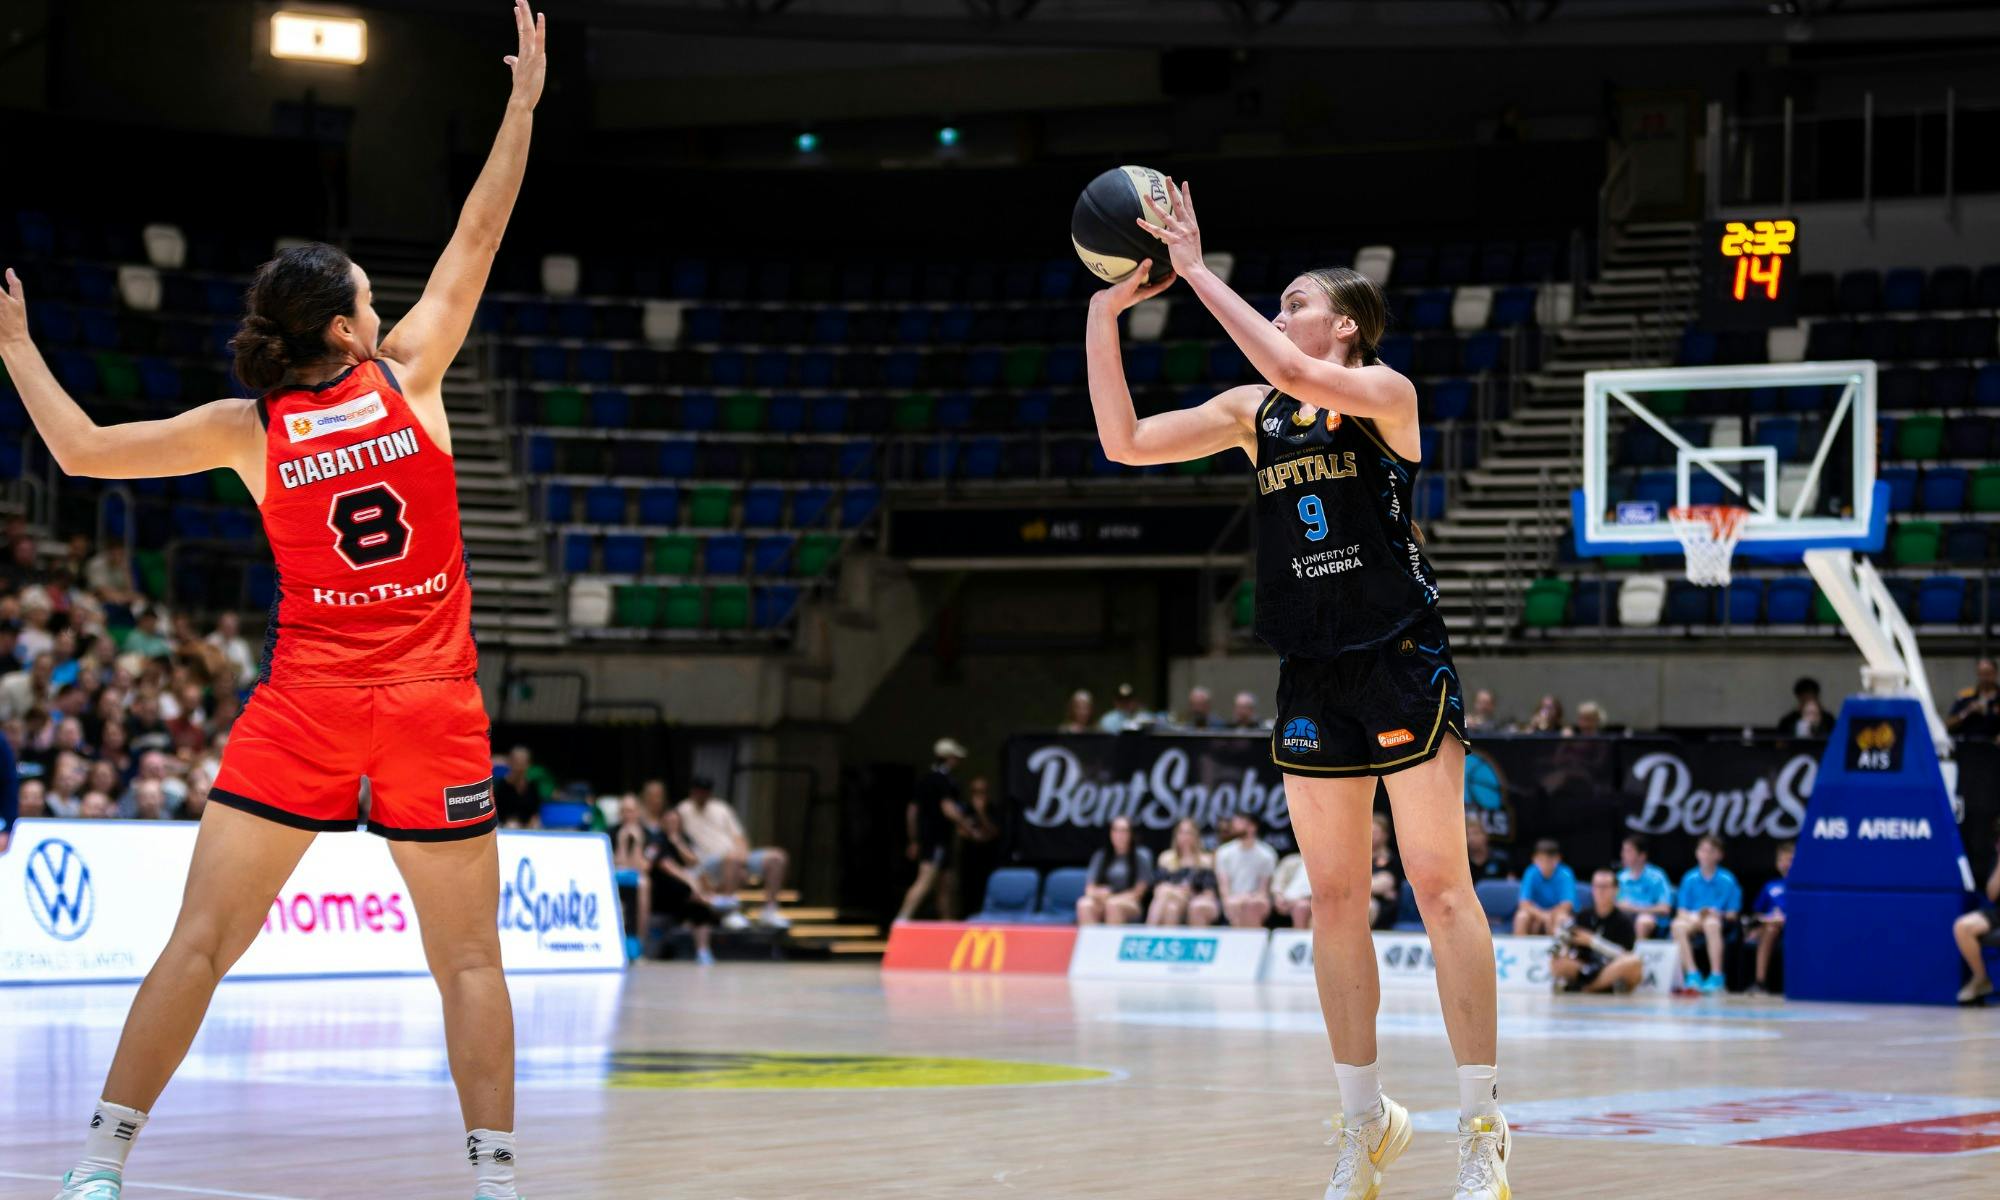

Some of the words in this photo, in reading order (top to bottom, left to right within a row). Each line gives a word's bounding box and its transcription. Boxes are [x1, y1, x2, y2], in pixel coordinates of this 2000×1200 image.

[1721, 221, 1796, 256] 2:32
[1734, 255, 1781, 301] 14
[278, 427, 419, 489] CIABATTONI
[1257, 451, 1357, 495] CAPITALS
[327, 481, 413, 570] 8
[1297, 494, 1329, 542] 9
[1346, 544, 1360, 555] OF
[1857, 751, 1891, 770] AIS
[1812, 817, 1849, 840] AIS
[1857, 817, 1932, 840] ARENA
[1123, 938, 1214, 961] REASN
